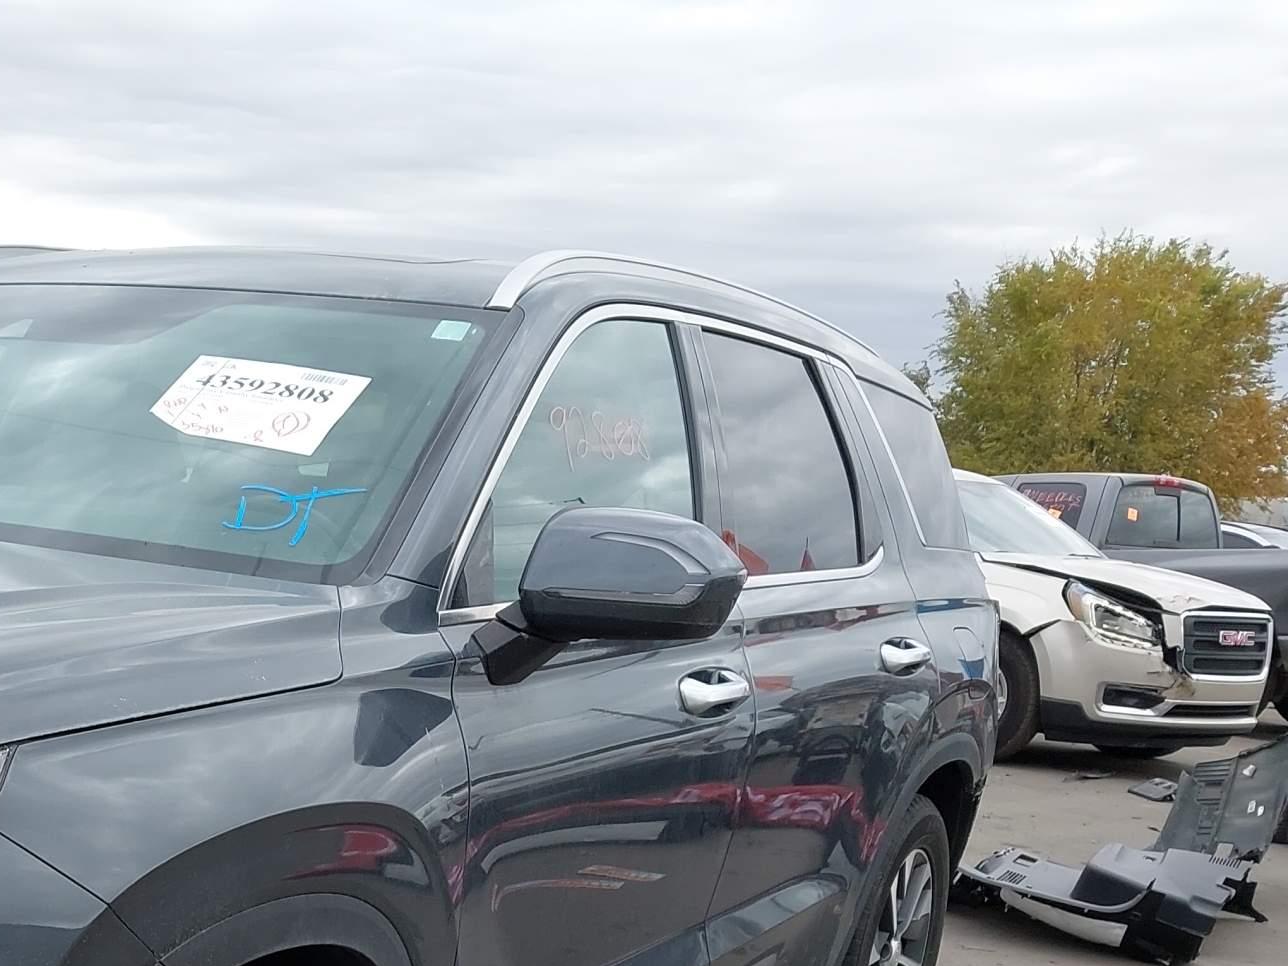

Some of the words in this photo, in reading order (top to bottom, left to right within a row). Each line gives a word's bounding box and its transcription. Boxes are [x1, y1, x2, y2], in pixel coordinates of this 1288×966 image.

[196, 372, 334, 405] 43592808
[222, 484, 368, 546] DT
[1219, 630, 1256, 646] GMC
